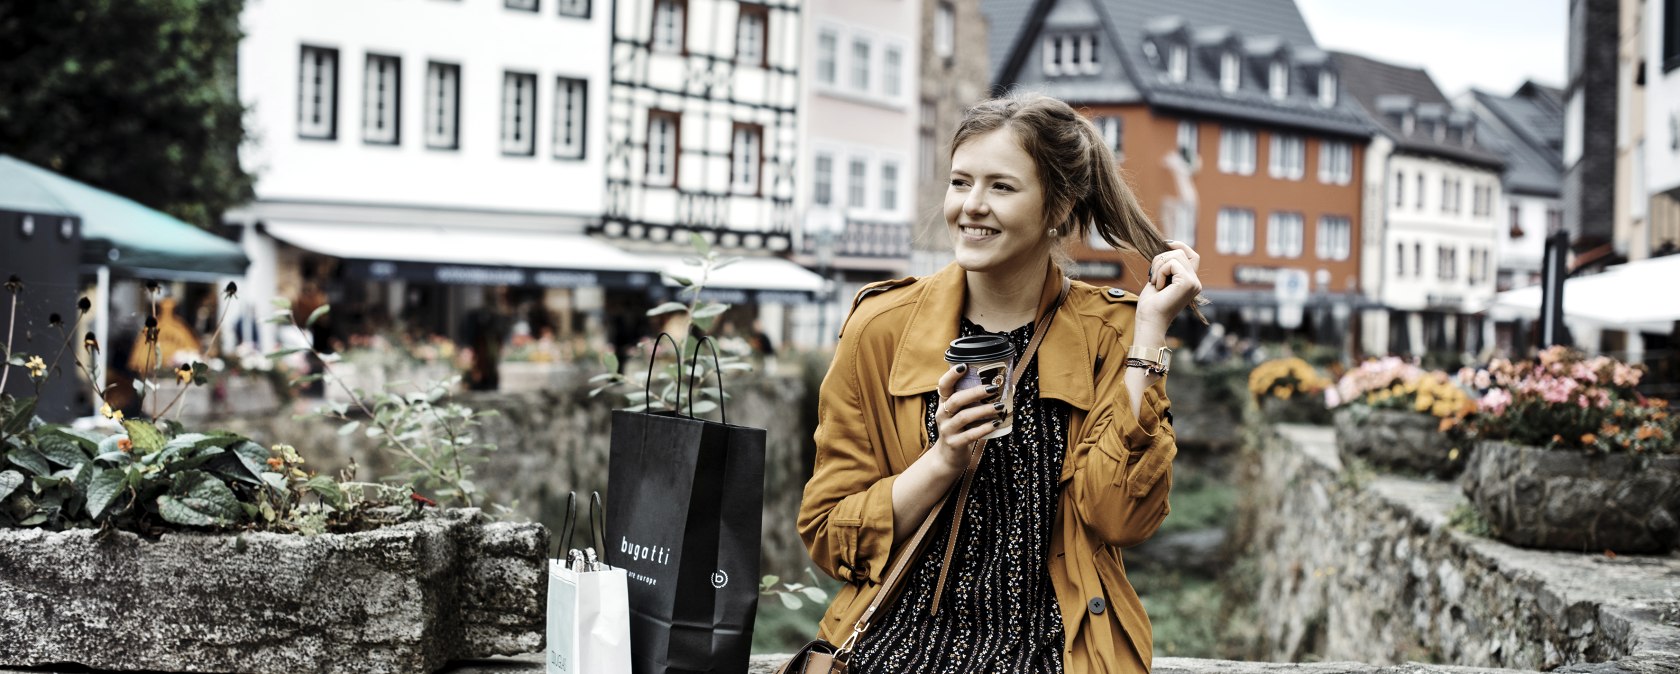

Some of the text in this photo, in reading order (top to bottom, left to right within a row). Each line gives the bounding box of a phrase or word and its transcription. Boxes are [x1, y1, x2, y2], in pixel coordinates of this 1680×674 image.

[621, 536, 670, 565] bugatti
[628, 571, 657, 585] are europe
